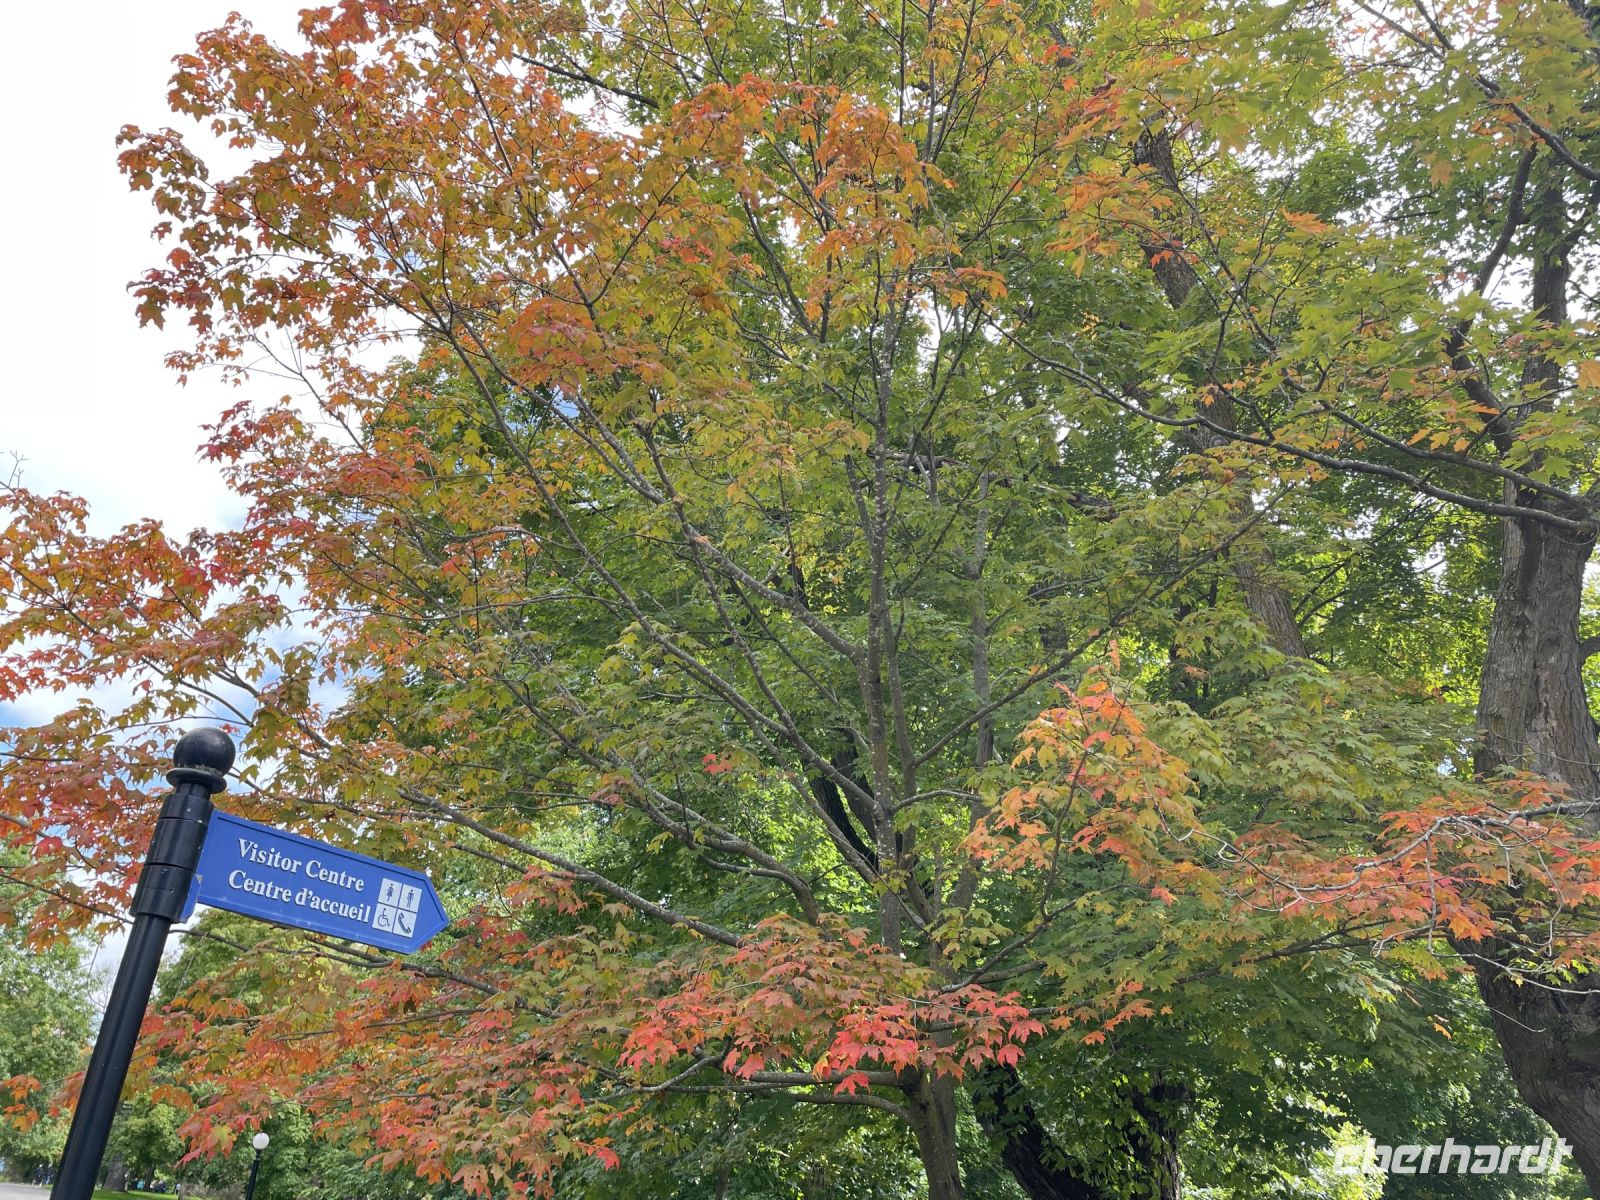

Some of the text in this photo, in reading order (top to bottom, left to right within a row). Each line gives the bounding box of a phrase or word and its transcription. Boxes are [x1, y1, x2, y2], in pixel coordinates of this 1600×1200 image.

[238, 838, 365, 892] Visitor Centre
[228, 869, 371, 923] Centre d'accueil
